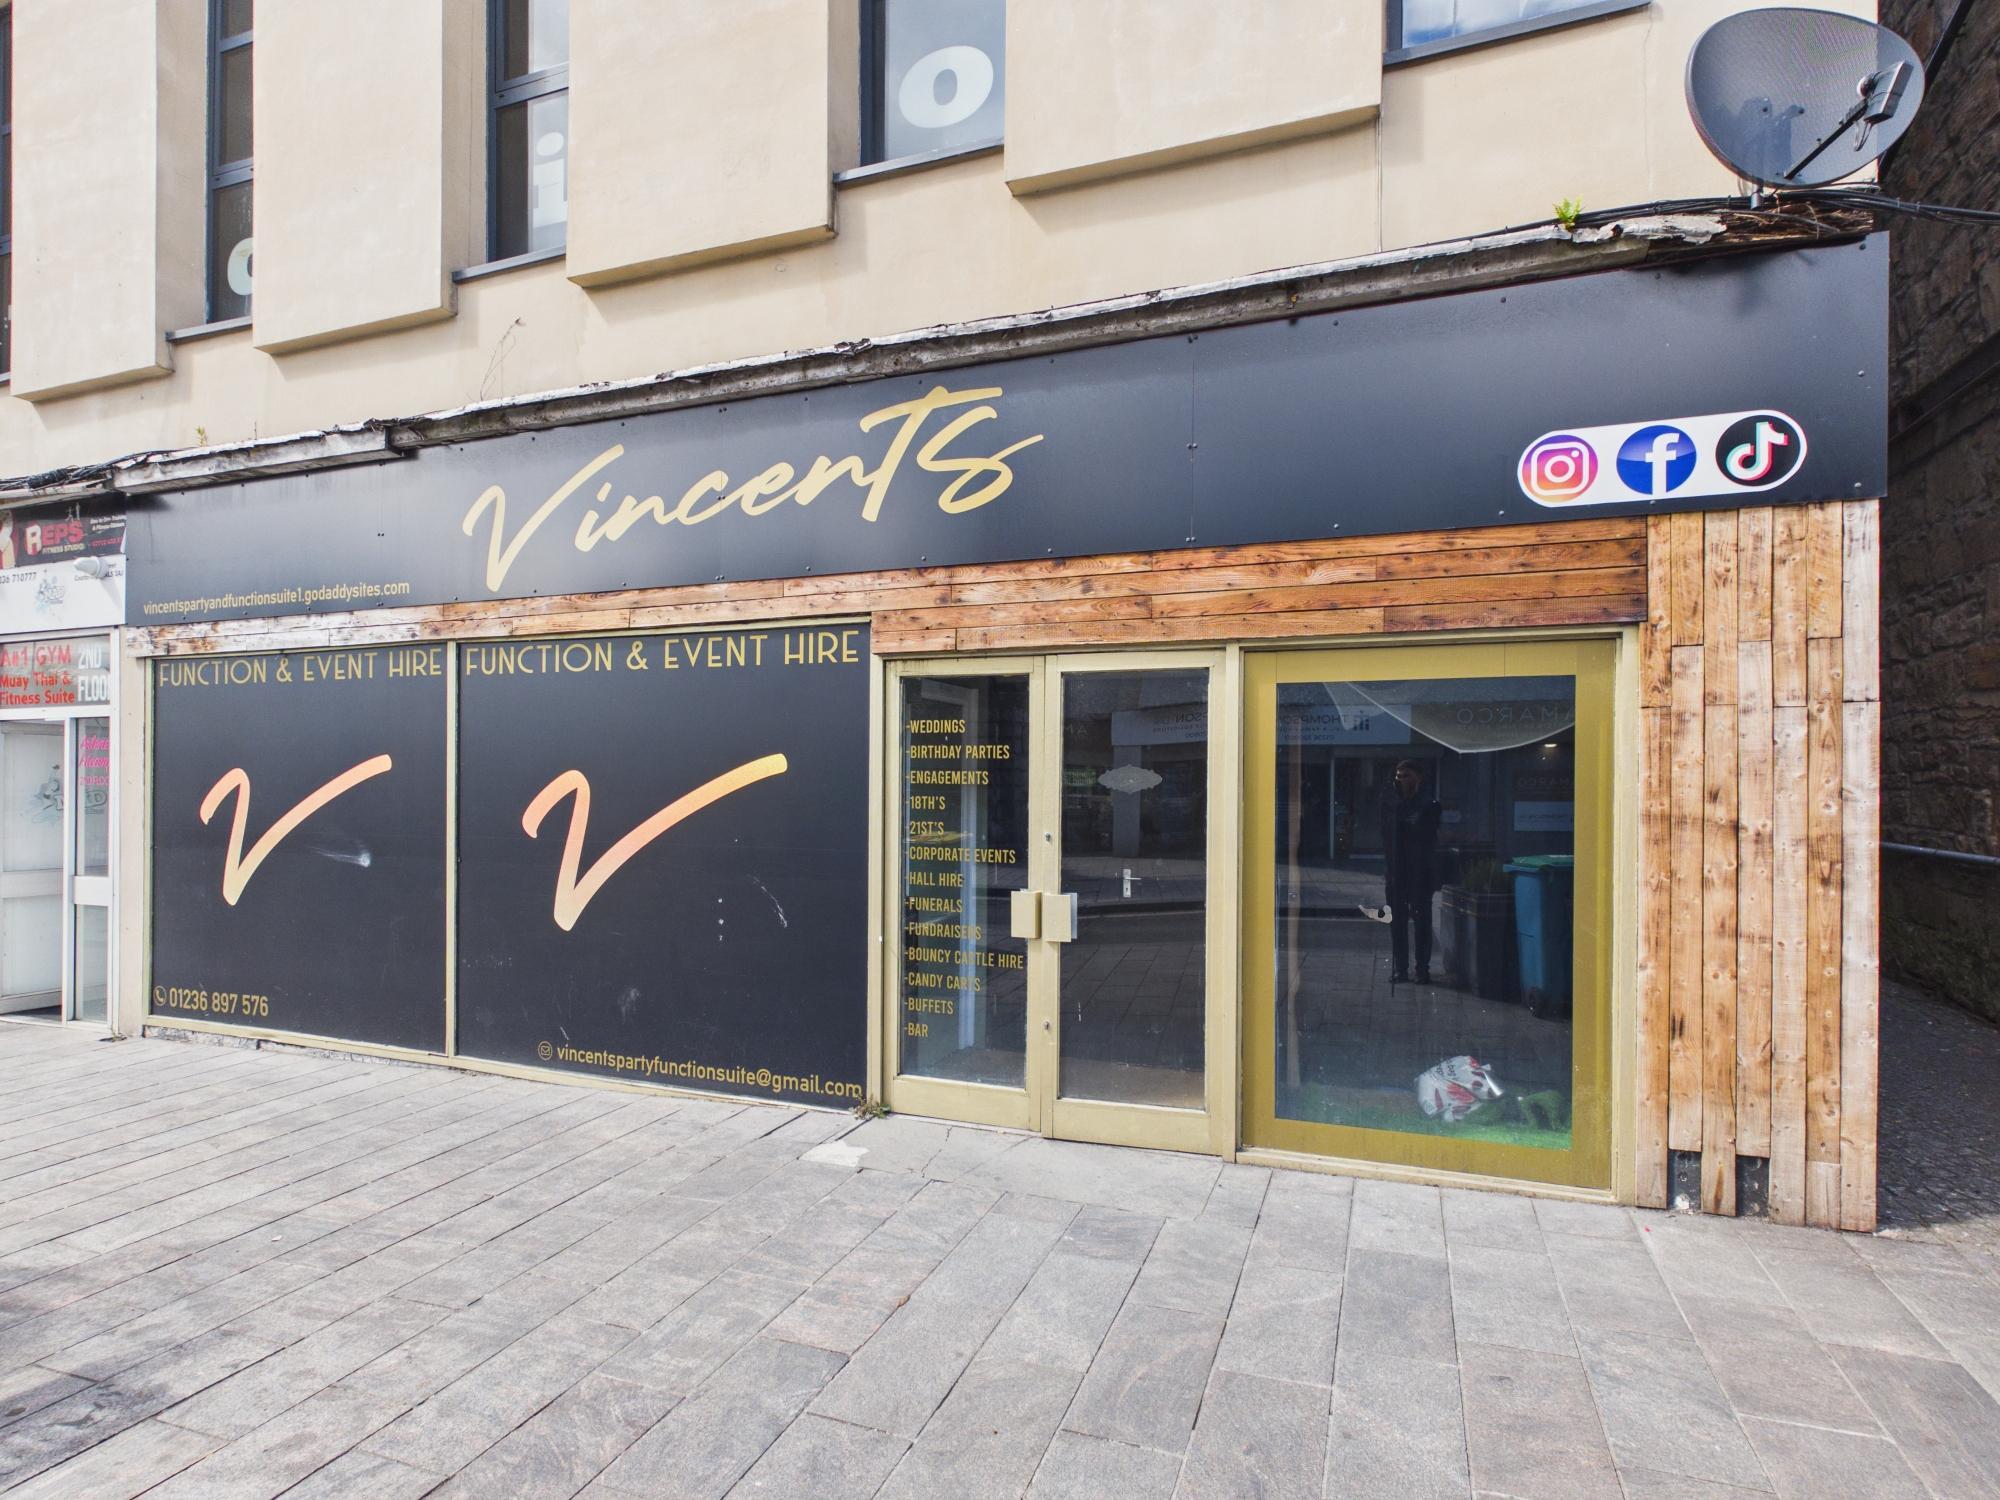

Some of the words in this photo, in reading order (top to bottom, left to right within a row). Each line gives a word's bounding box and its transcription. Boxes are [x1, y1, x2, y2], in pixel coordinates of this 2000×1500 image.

[24, 518, 84, 556] REPS
[143, 581, 410, 616] vincentspartyandfunctionsuite1.godaddysites.com
[36, 644, 72, 666] GYM
[78, 645, 102, 670] 2ND
[466, 642, 612, 676] FUNCTION
[626, 640, 649, 670] &
[664, 634, 768, 669] EVENT
[784, 630, 859, 665] HIRE
[160, 658, 267, 688] FUNCTION
[276, 657, 293, 683] &
[303, 652, 378, 682] EVENT
[388, 648, 442, 678] HIRE
[0, 674, 29, 691] Muay
[32, 670, 58, 687] Thai
[62, 671, 73, 685] &
[78, 674, 110, 702] FLOO
[0, 691, 41, 705] Fitness
[44, 689, 75, 705] Suite
[965, 745, 1010, 759] PARTIES
[974, 849, 1016, 864] EVENTS
[939, 873, 964, 888] HIRE
[954, 950, 995, 967] CASTLE
[998, 955, 1024, 969] HIRE
[946, 975, 981, 992] CARTS
[169, 987, 208, 1011] 01236
[211, 992, 238, 1014] 897
[242, 995, 269, 1017] 576
[557, 1044, 862, 1098] vincentspartyfunctionsuite@gmail.com
